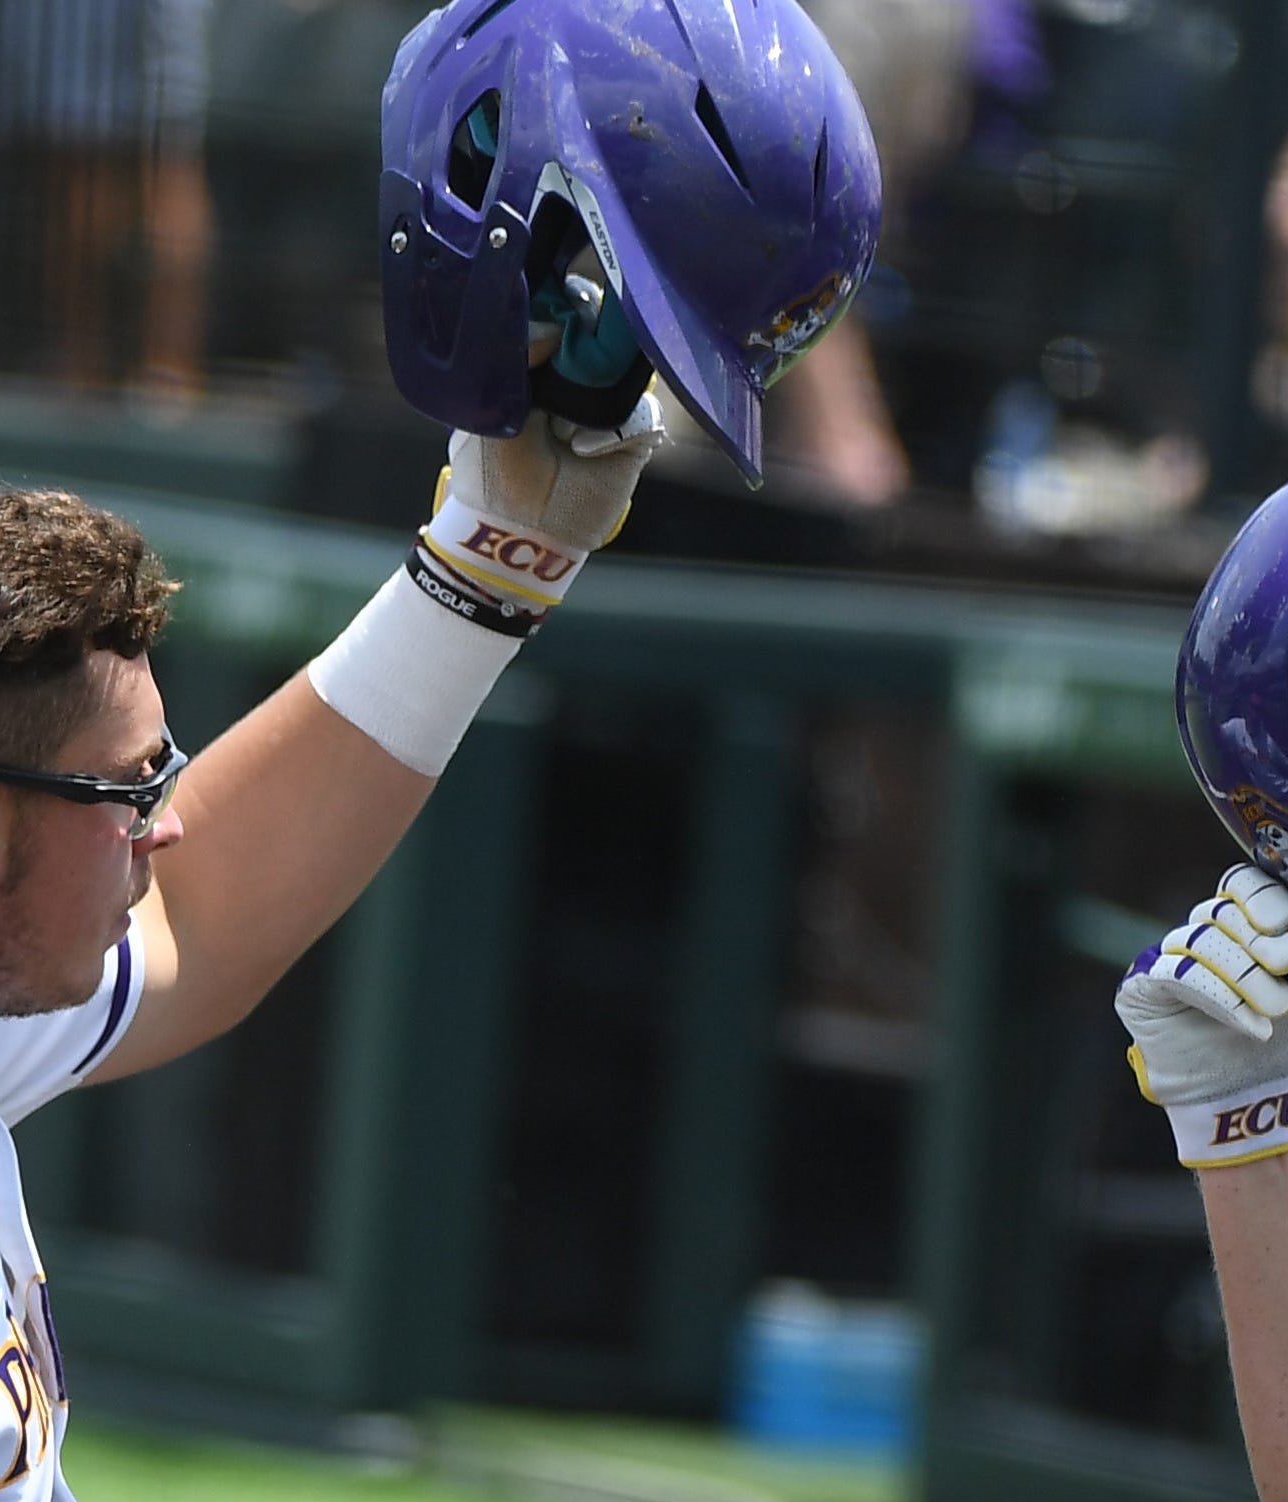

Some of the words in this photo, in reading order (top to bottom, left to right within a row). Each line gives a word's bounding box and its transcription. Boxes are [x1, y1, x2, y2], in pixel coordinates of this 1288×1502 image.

[589, 210, 617, 270] EASTON
[457, 520, 577, 582] ECU
[416, 569, 478, 618] ROGUE
